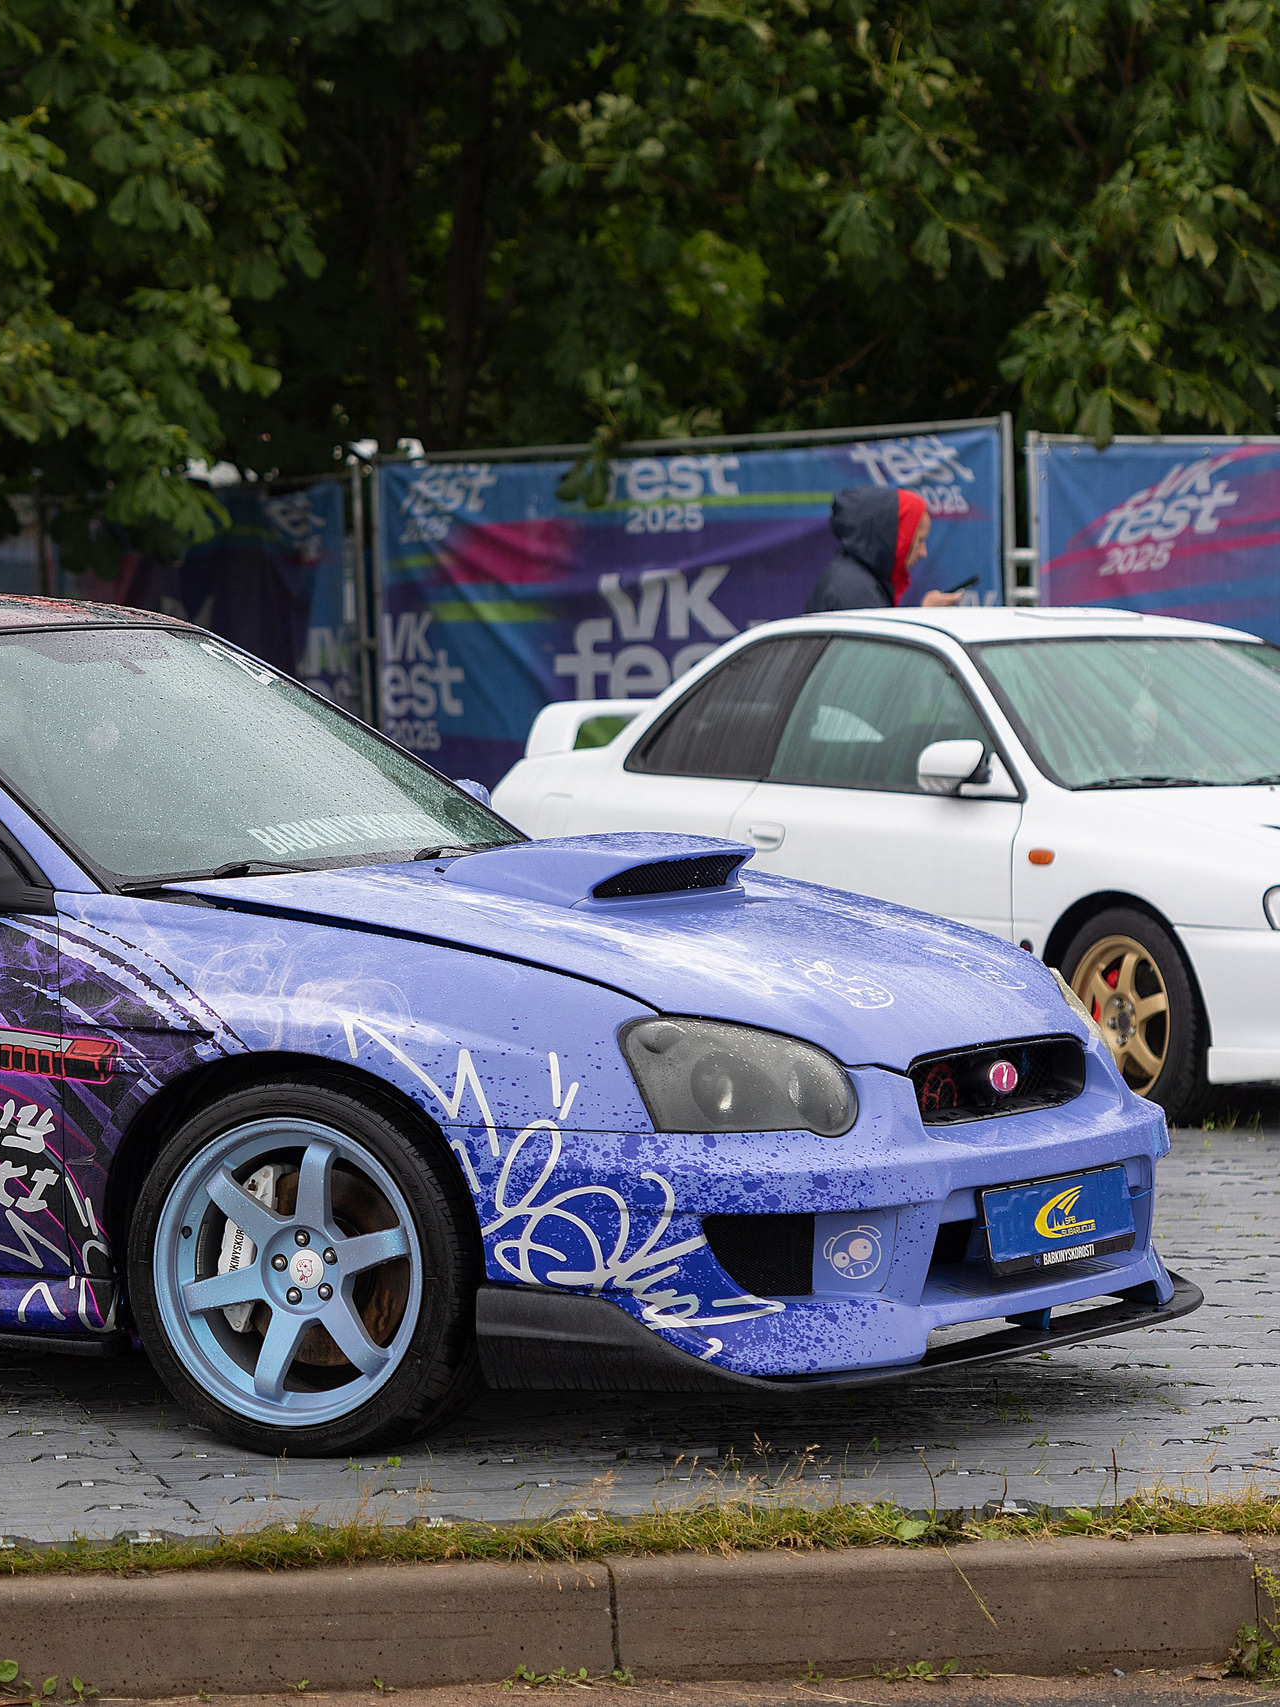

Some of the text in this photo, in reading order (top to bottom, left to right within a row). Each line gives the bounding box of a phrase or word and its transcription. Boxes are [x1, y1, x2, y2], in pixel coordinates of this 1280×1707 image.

[625, 502, 704, 534] 2025
[913, 484, 969, 516] 025
[1099, 541, 1175, 577] 2025
[597, 564, 740, 640] VK
[383, 611, 434, 662] VK
[381, 649, 466, 719] est
[228, 1226, 246, 1272] KINYSKOR
